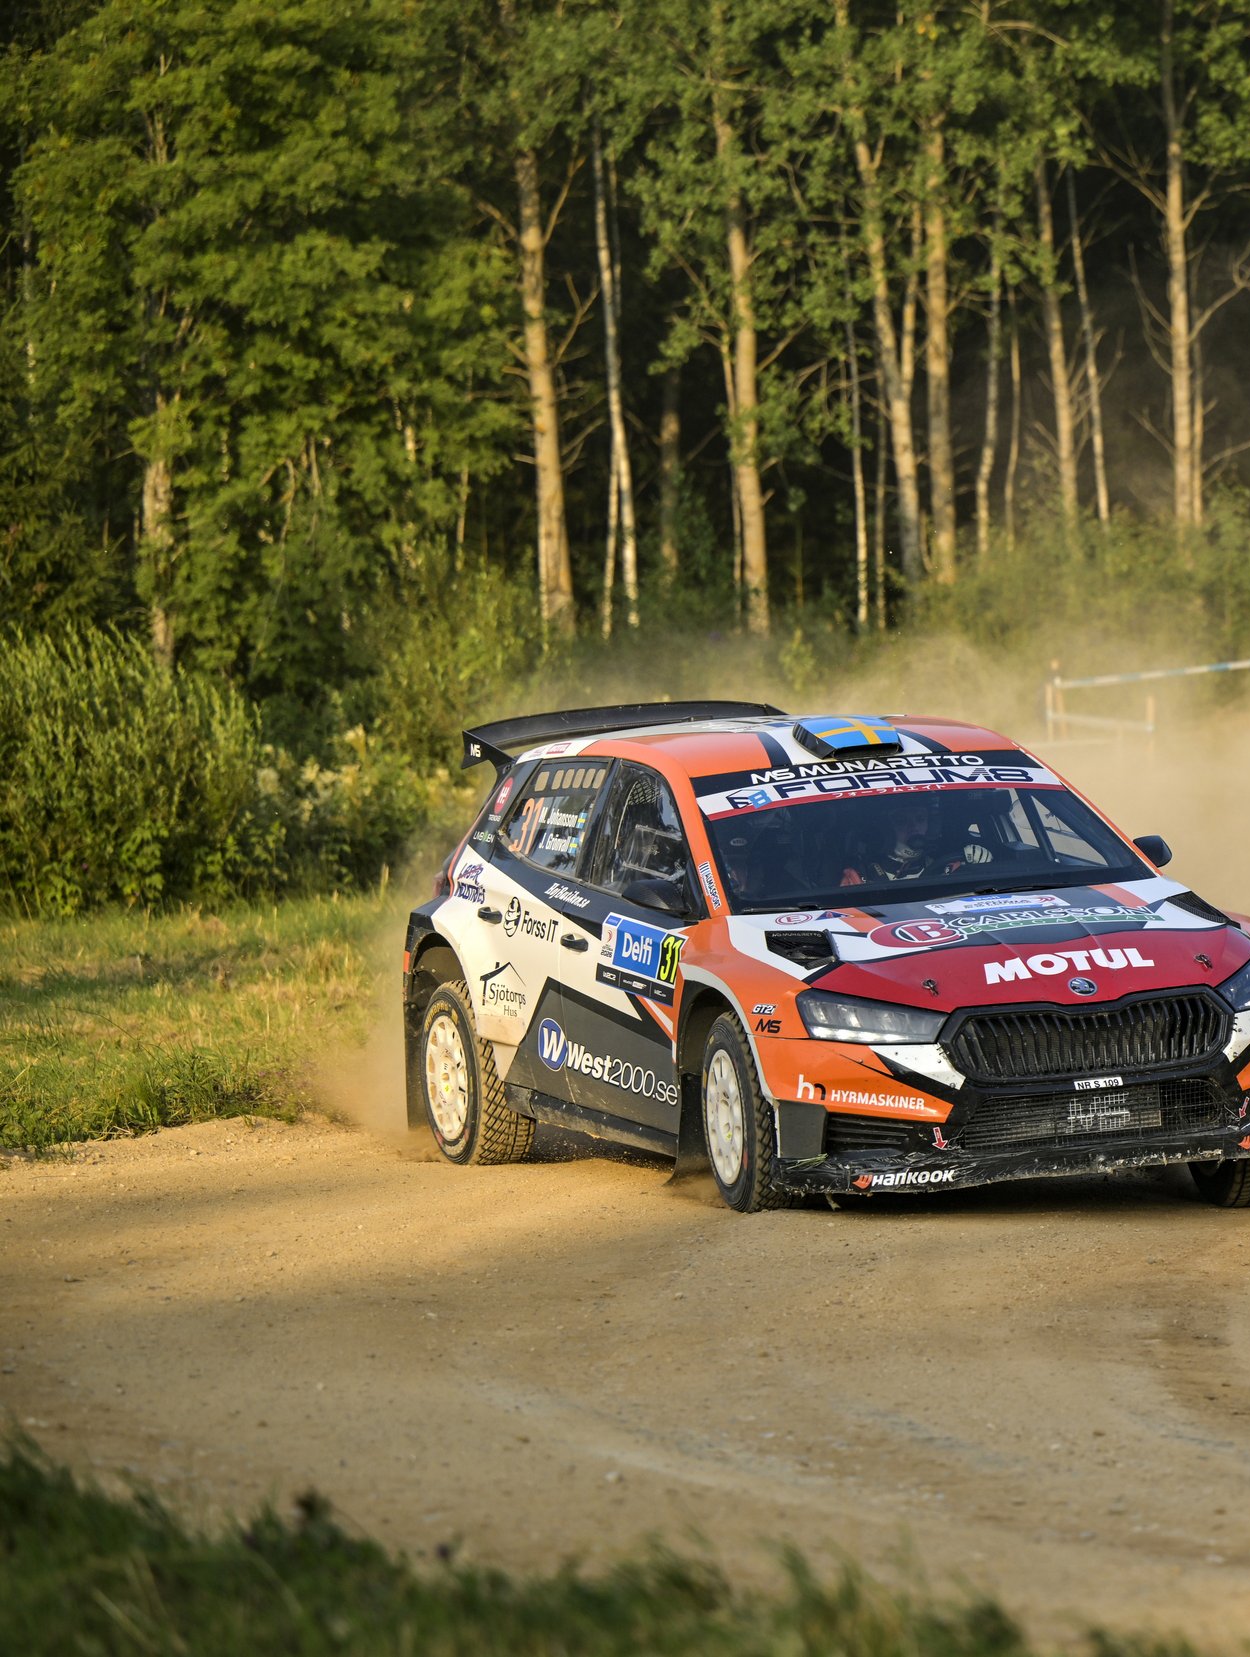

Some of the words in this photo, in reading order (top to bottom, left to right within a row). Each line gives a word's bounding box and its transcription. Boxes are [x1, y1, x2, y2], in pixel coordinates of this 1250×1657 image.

[470, 743, 482, 757] MS
[750, 768, 796, 785] MS
[799, 755, 985, 778] MUNARETTO
[773, 767, 1034, 799] FORUM8
[832, 784, 947, 798] フォーラムエイト
[508, 797, 545, 855] 31
[547, 808, 579, 828] Johansson
[521, 911, 546, 940] Forss
[546, 919, 559, 943] IT
[948, 906, 1157, 928] CARLSSON
[622, 932, 653, 966] Delfi
[660, 936, 684, 983] 31
[983, 948, 1156, 985] MOTUL
[489, 983, 527, 1010] Sjötorps
[503, 1005, 517, 1018] Hus
[755, 1018, 782, 1034] MS
[542, 1027, 566, 1063] W
[567, 1040, 679, 1106] West2000.se
[1077, 1081, 1092, 1090] NR
[1094, 1080, 1101, 1089] S
[1104, 1078, 1120, 1087] 109
[831, 1089, 925, 1111] HYRMASKINER
